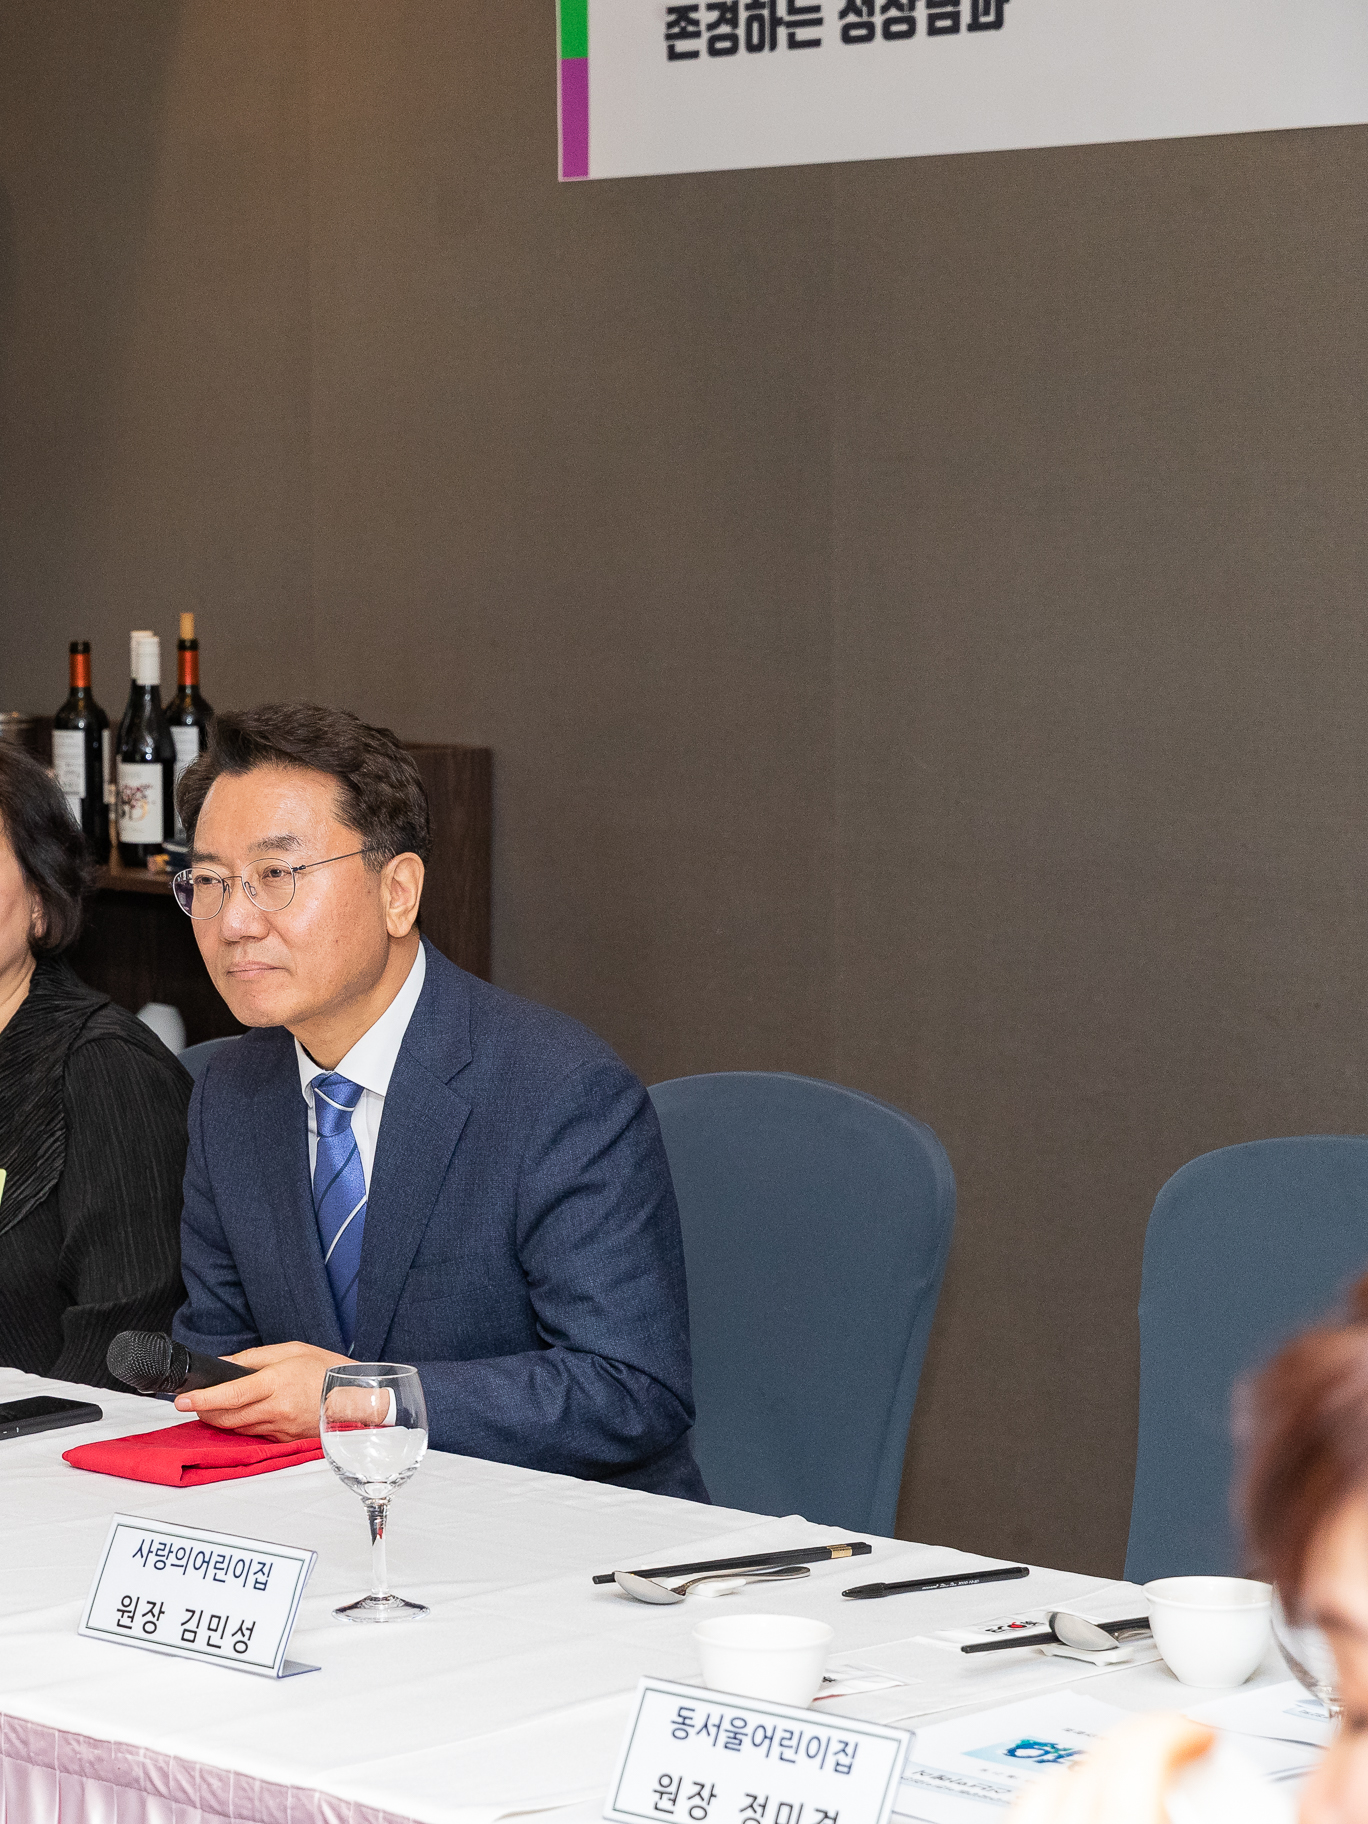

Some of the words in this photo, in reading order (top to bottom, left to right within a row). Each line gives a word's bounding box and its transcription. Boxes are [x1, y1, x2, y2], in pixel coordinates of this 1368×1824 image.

[665, 0, 823, 61] 존경하는
[132, 1538, 274, 1592] 사랑의어린이집
[116, 1594, 165, 1635] 원장
[180, 1608, 257, 1655] 김민성
[670, 1706, 859, 1775] 동서울어린이집
[653, 1773, 717, 1821] 원장
